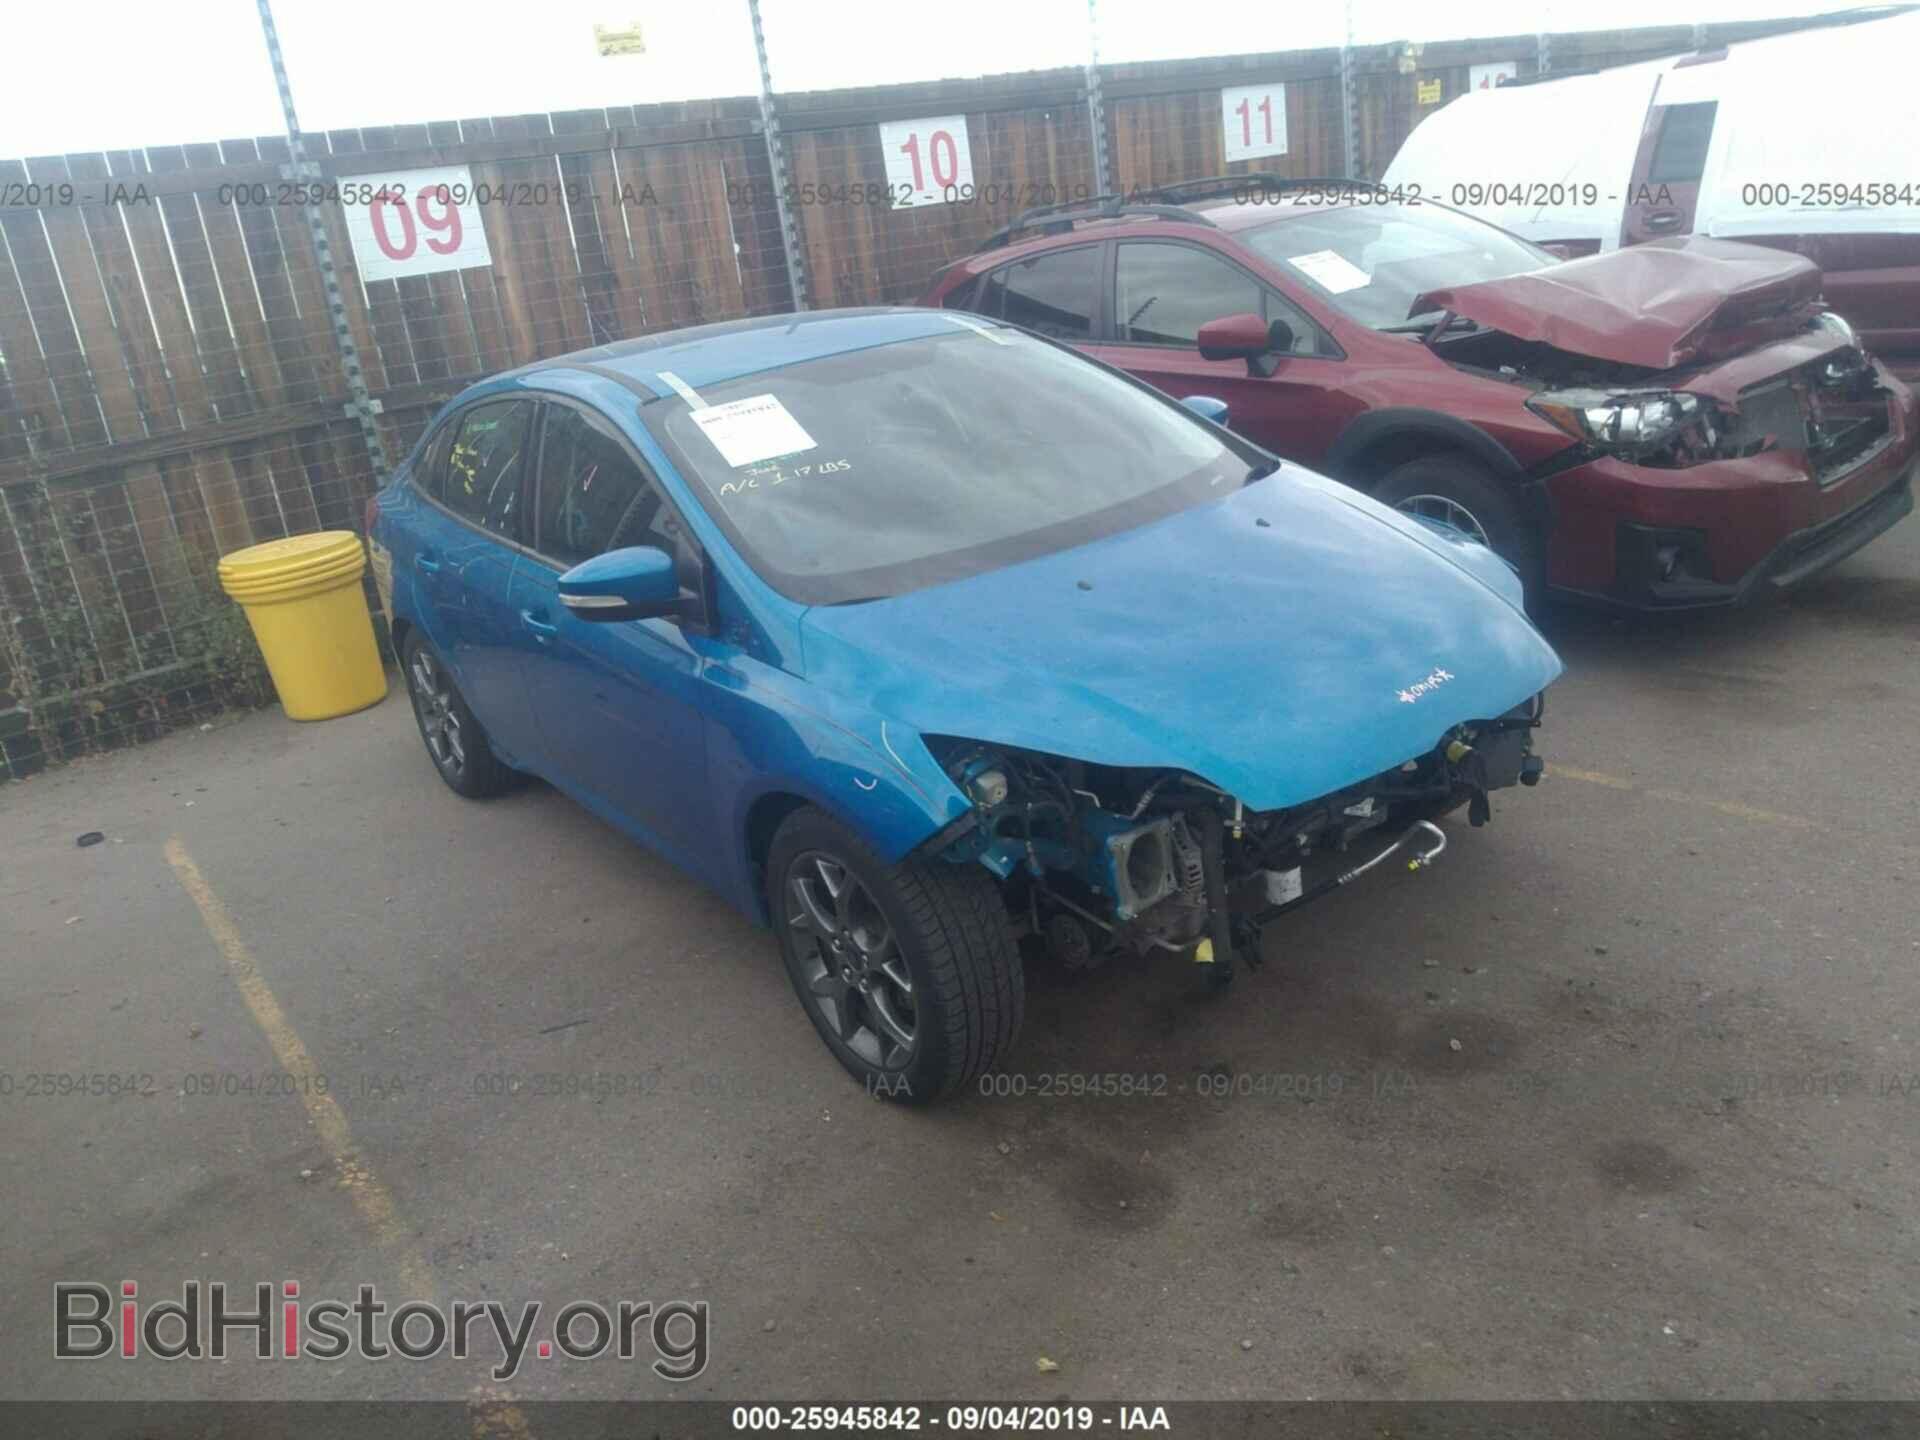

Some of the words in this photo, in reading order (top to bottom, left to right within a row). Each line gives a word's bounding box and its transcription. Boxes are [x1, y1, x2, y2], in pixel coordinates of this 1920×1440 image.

[1234, 95, 1275, 147] 11
[901, 130, 959, 192] 10
[370, 184, 465, 261] 09
